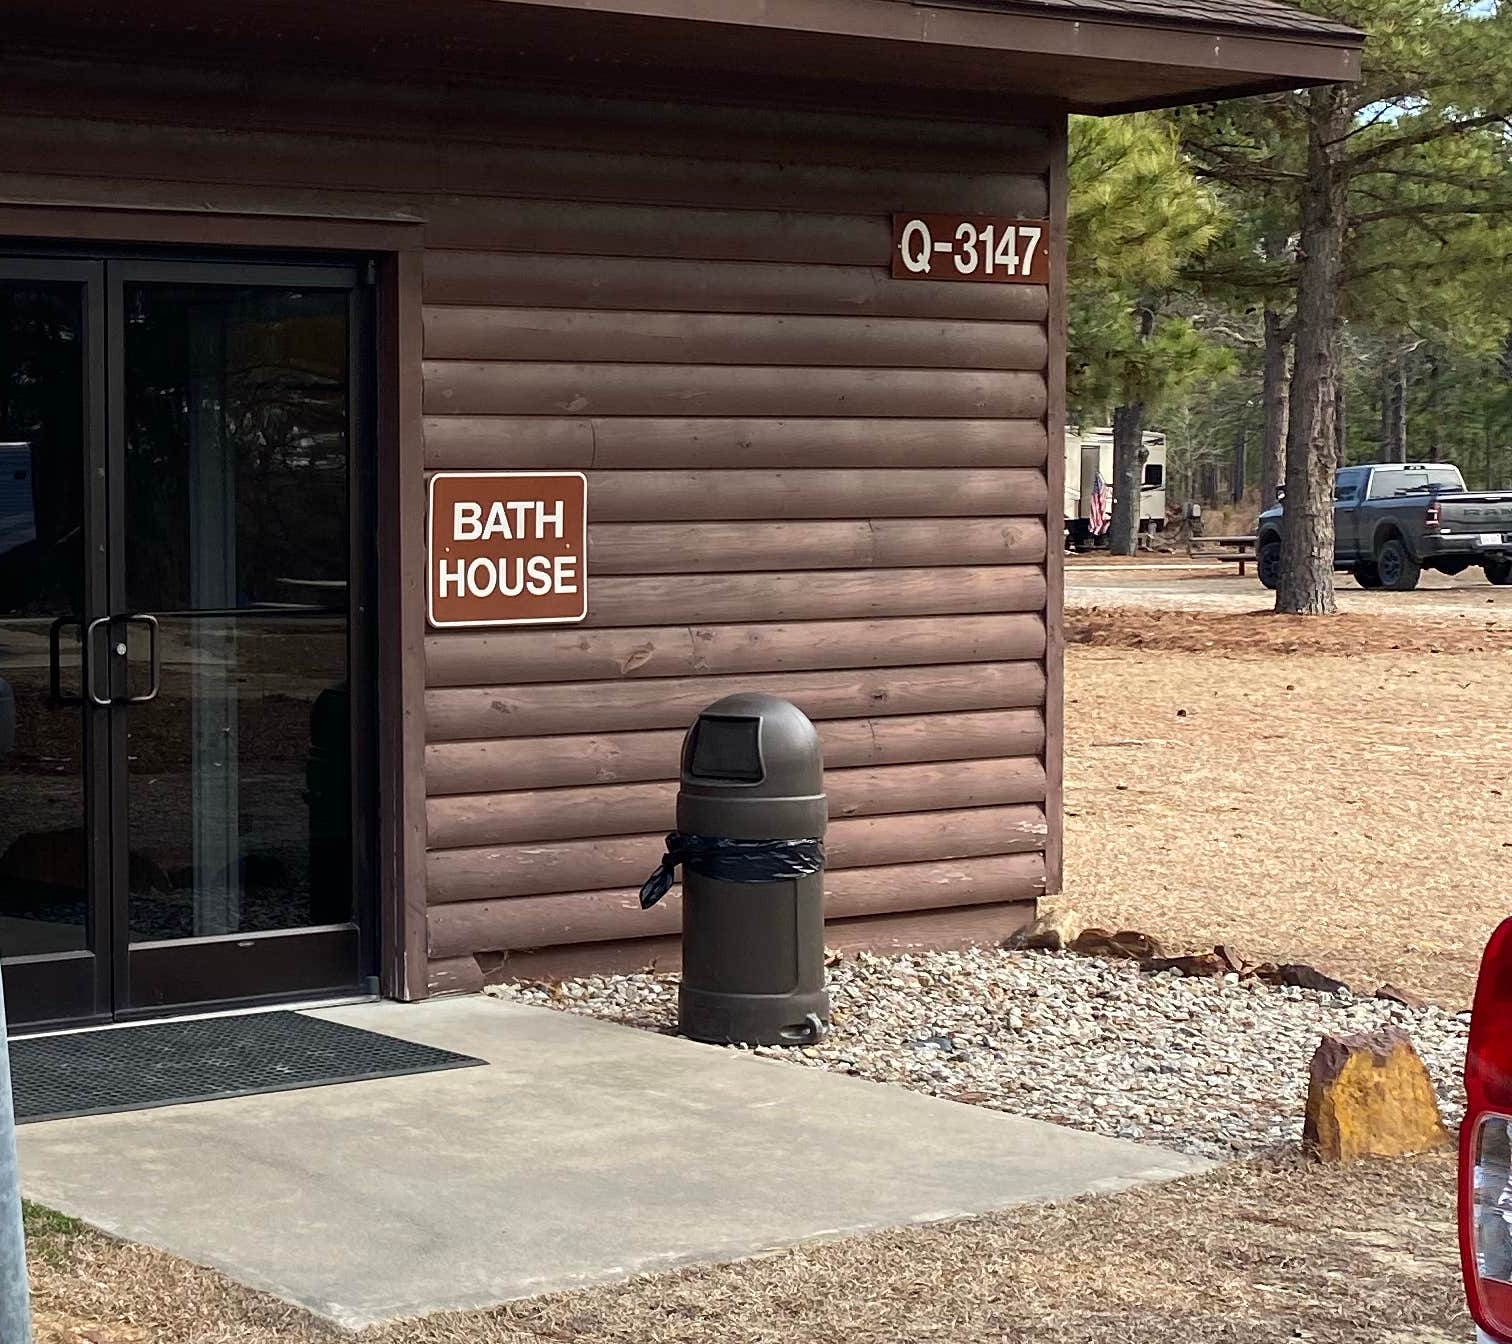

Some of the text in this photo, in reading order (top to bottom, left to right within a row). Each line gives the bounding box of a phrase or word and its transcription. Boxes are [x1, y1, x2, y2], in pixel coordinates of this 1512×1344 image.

[901, 219, 1042, 276] Q-3147
[453, 500, 564, 540] BATH
[439, 555, 577, 598] HOUSE
